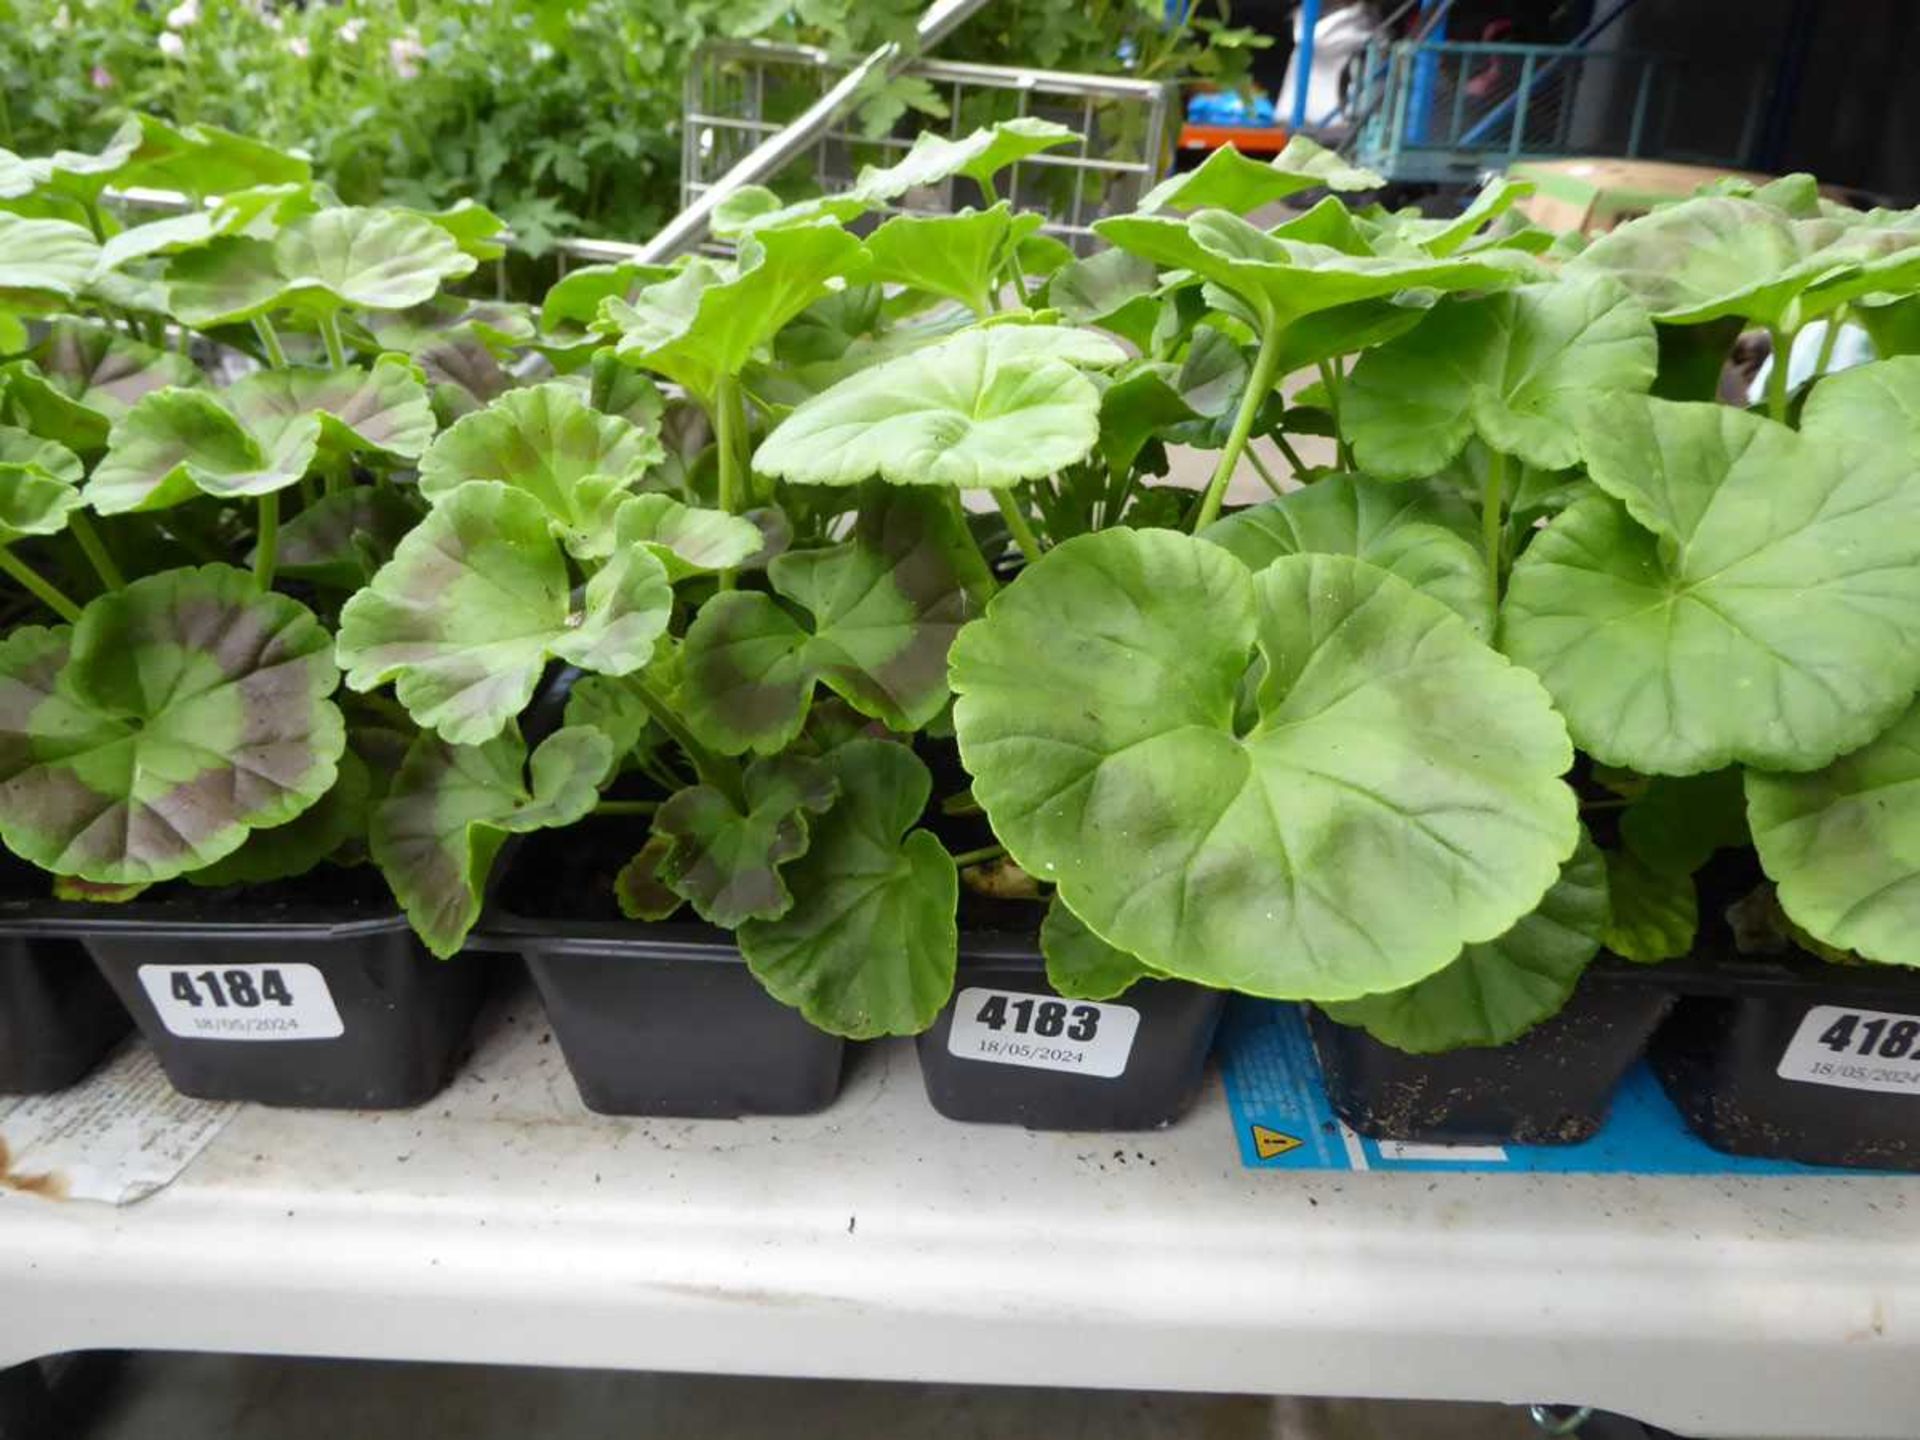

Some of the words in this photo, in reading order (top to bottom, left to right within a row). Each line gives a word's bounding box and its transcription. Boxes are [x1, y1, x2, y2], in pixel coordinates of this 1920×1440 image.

[170, 969, 294, 1008] 4184
[976, 995, 1101, 1042] 4183
[1817, 1013, 1920, 1061] 418
[979, 1039, 1085, 1063] 18/05/2024
